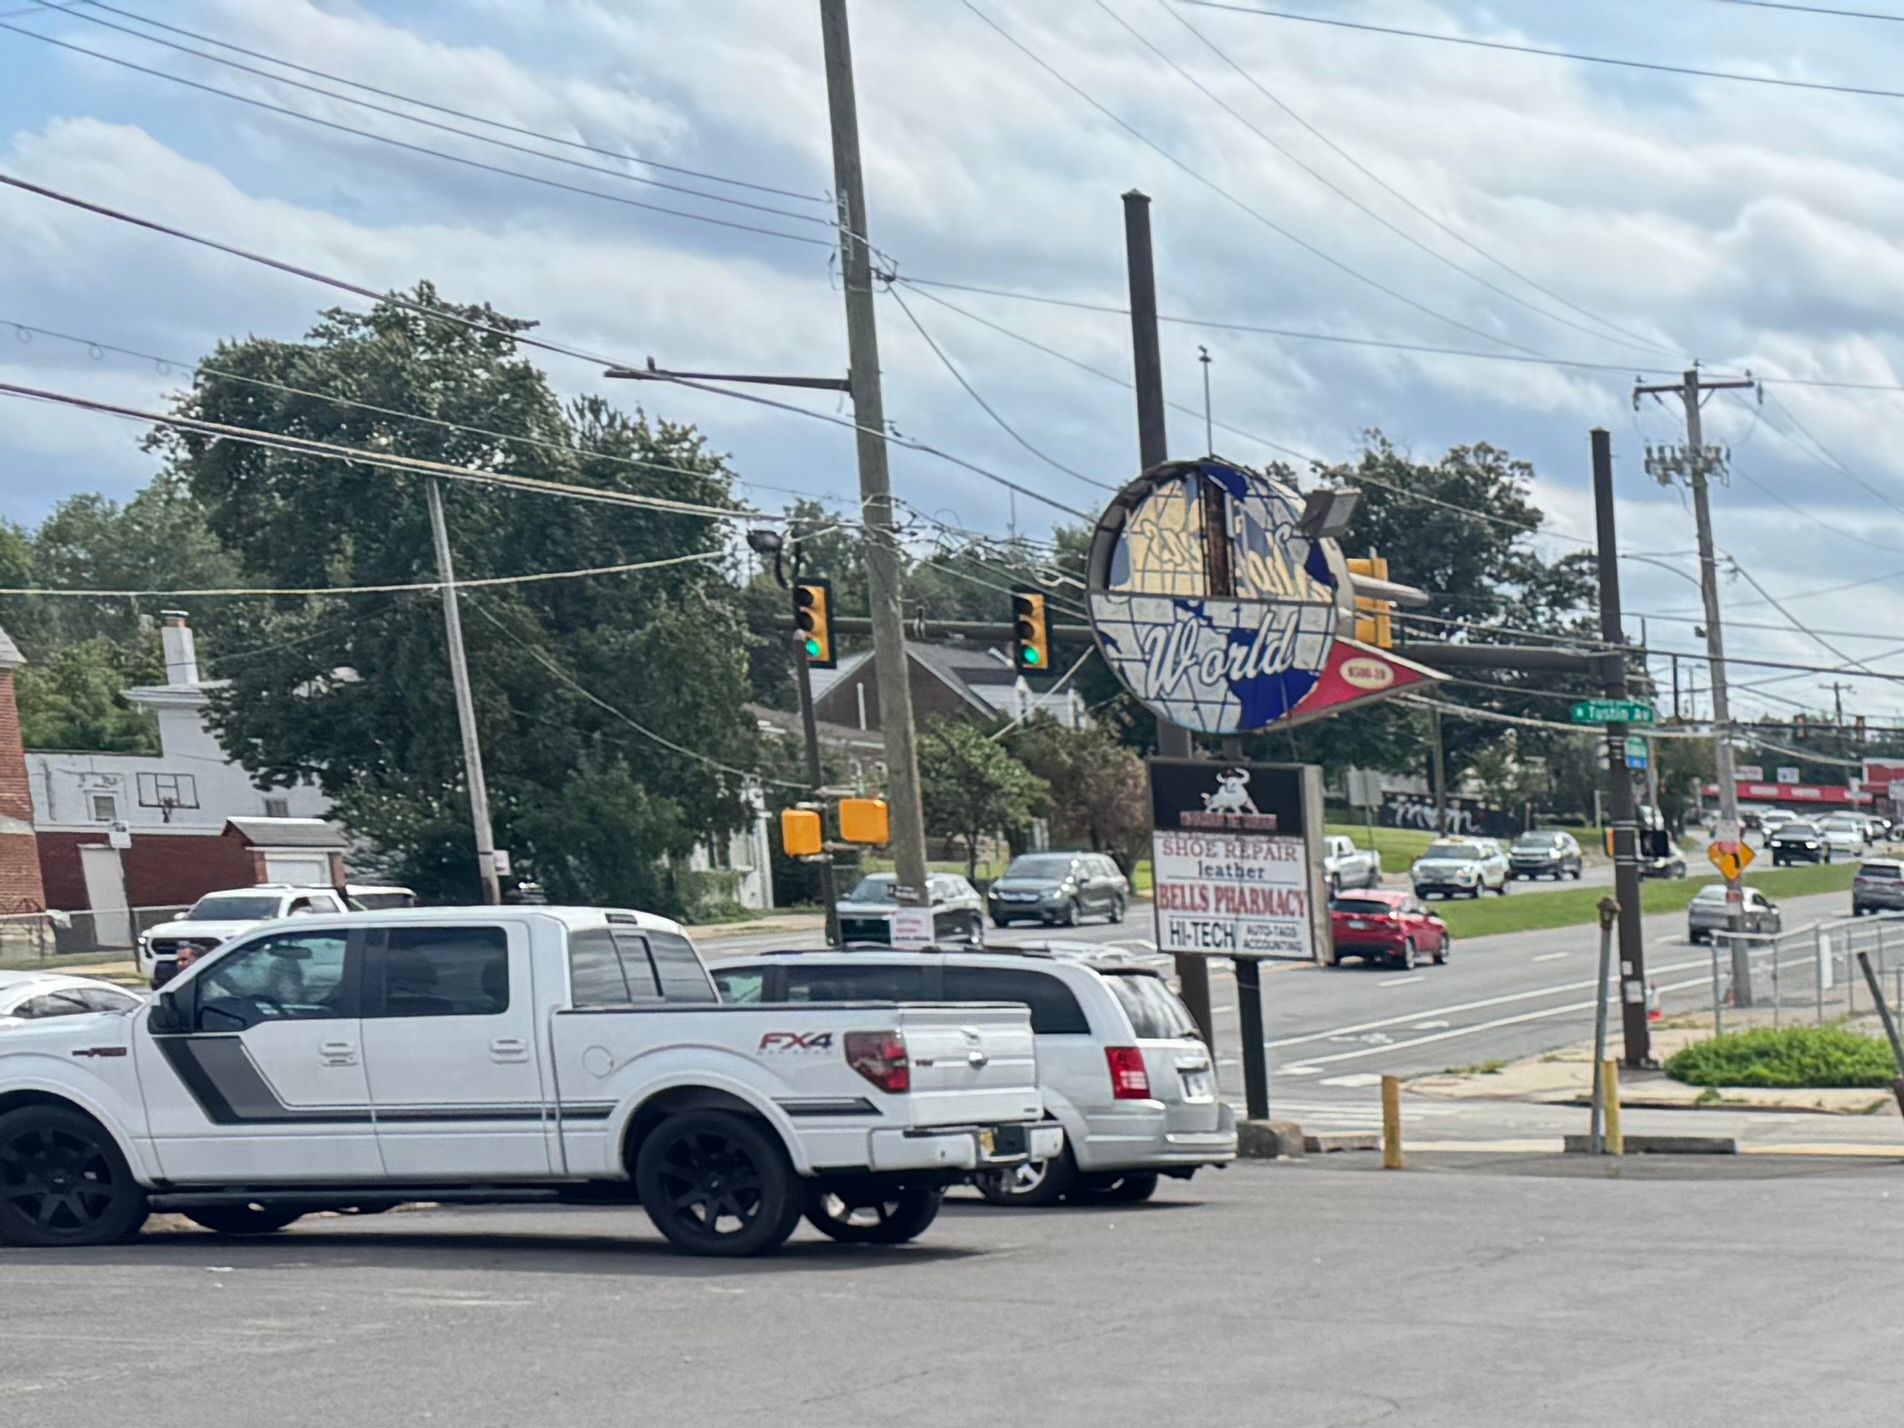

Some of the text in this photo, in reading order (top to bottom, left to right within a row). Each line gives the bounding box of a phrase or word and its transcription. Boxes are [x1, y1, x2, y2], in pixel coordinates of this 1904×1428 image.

[1143, 611, 1300, 700] World
[1589, 705, 1630, 720] Tustin
[1162, 838, 1299, 863] SHOE REPAIR
[1198, 861, 1265, 880] leather
[1159, 884, 1305, 918] BELLS PHARMACY
[1170, 920, 1235, 948] HI-TECH
[758, 1032, 833, 1050] FX4
